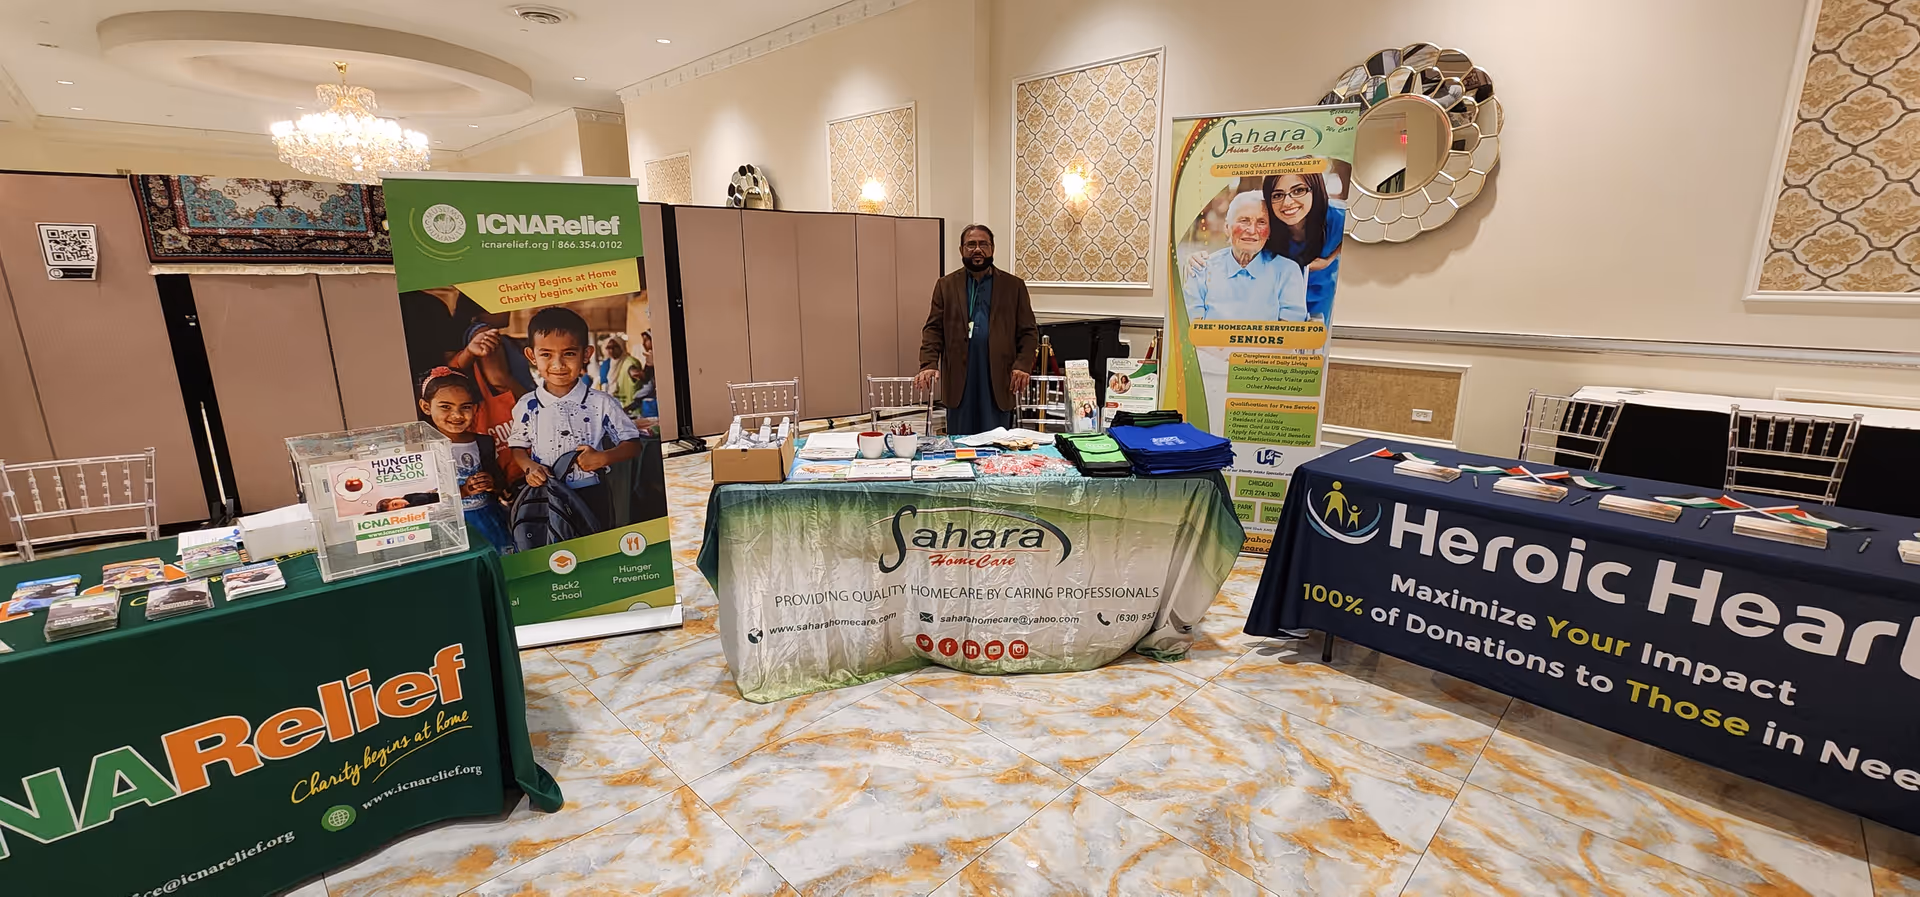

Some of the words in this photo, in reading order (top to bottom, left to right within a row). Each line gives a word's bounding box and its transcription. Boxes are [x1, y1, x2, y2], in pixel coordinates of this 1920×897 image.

[1212, 119, 1306, 158] Sahara
[1225, 146, 1249, 154] Asian
[1252, 144, 1282, 153] Elderly
[1284, 143, 1304, 151] Care
[476, 214, 620, 236] ICNARelief
[481, 240, 548, 250] icnarelief.org
[558, 240, 622, 249] 866.354.0102
[498, 281, 536, 294] Charity
[539, 276, 572, 289] Begins
[576, 273, 586, 282] at
[588, 268, 616, 280] Home
[500, 292, 536, 305] Charity
[540, 288, 573, 300] begins
[576, 283, 598, 293] with
[600, 280, 618, 290] You
[1229, 335, 1284, 345] SENIORS
[371, 454, 422, 469] HUNGER
[377, 465, 402, 476] HAS
[405, 462, 423, 472] NO
[376, 470, 428, 484] SEASON.
[358, 512, 426, 530] ICNARelief
[368, 525, 420, 538] www.icnarelief.org
[878, 504, 1044, 574] Sahara
[928, 553, 1016, 568] HomeCare
[1389, 502, 1632, 604] Heroic
[619, 563, 652, 574] Hunger
[552, 580, 579, 592] Back2
[612, 572, 660, 584] Prevention
[551, 591, 582, 602] School
[775, 590, 849, 607] PROVIDING
[852, 584, 907, 603] QUALITY
[910, 585, 983, 600] HOMECARE
[987, 588, 1002, 600] BY
[1004, 586, 1054, 599] CARING
[1057, 587, 1159, 600] PROFESSIONALS
[770, 611, 897, 635] www.saharahomecare.com
[940, 615, 1080, 626] saharahomecare@yahoo.com
[1116, 614, 1139, 623] (630)
[1390, 573, 1537, 631] Maximize
[1546, 616, 1631, 657] Your
[1640, 642, 1798, 706] Impact
[1302, 583, 1364, 616] 100%
[1370, 605, 1400, 627] of
[1406, 613, 1565, 679] Donations
[1575, 664, 1614, 693] to
[1626, 678, 1750, 737] Those
[1762, 720, 1805, 756] in
[291, 760, 362, 804] Charity
[360, 733, 411, 768] begins
[414, 722, 431, 741] at
[436, 710, 469, 732] home
[362, 764, 483, 810] www.icnarelief.org
